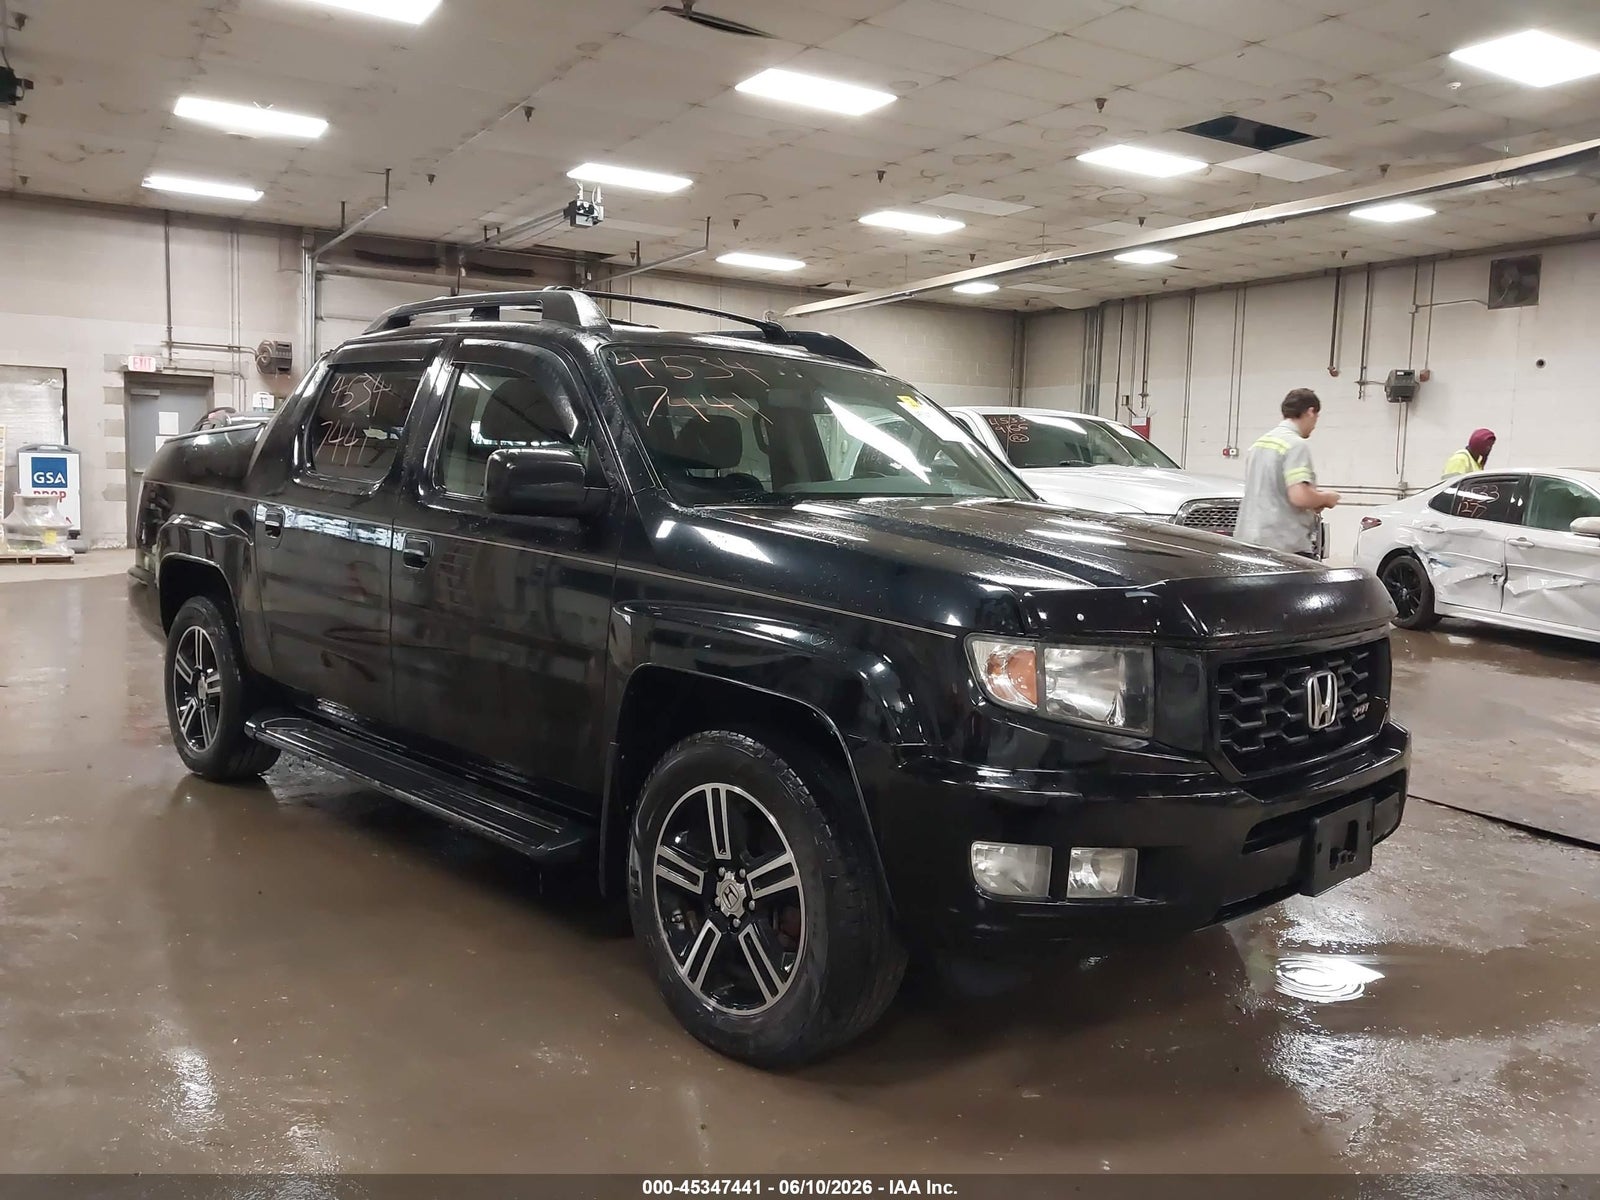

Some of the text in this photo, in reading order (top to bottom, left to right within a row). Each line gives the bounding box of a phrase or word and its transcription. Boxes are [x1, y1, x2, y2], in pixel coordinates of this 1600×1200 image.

[132, 357, 153, 370] EXIT
[611, 350, 770, 387] 4534
[331, 373, 392, 416] 4534
[633, 385, 774, 426] 7441
[33, 472, 66, 484] GSA
